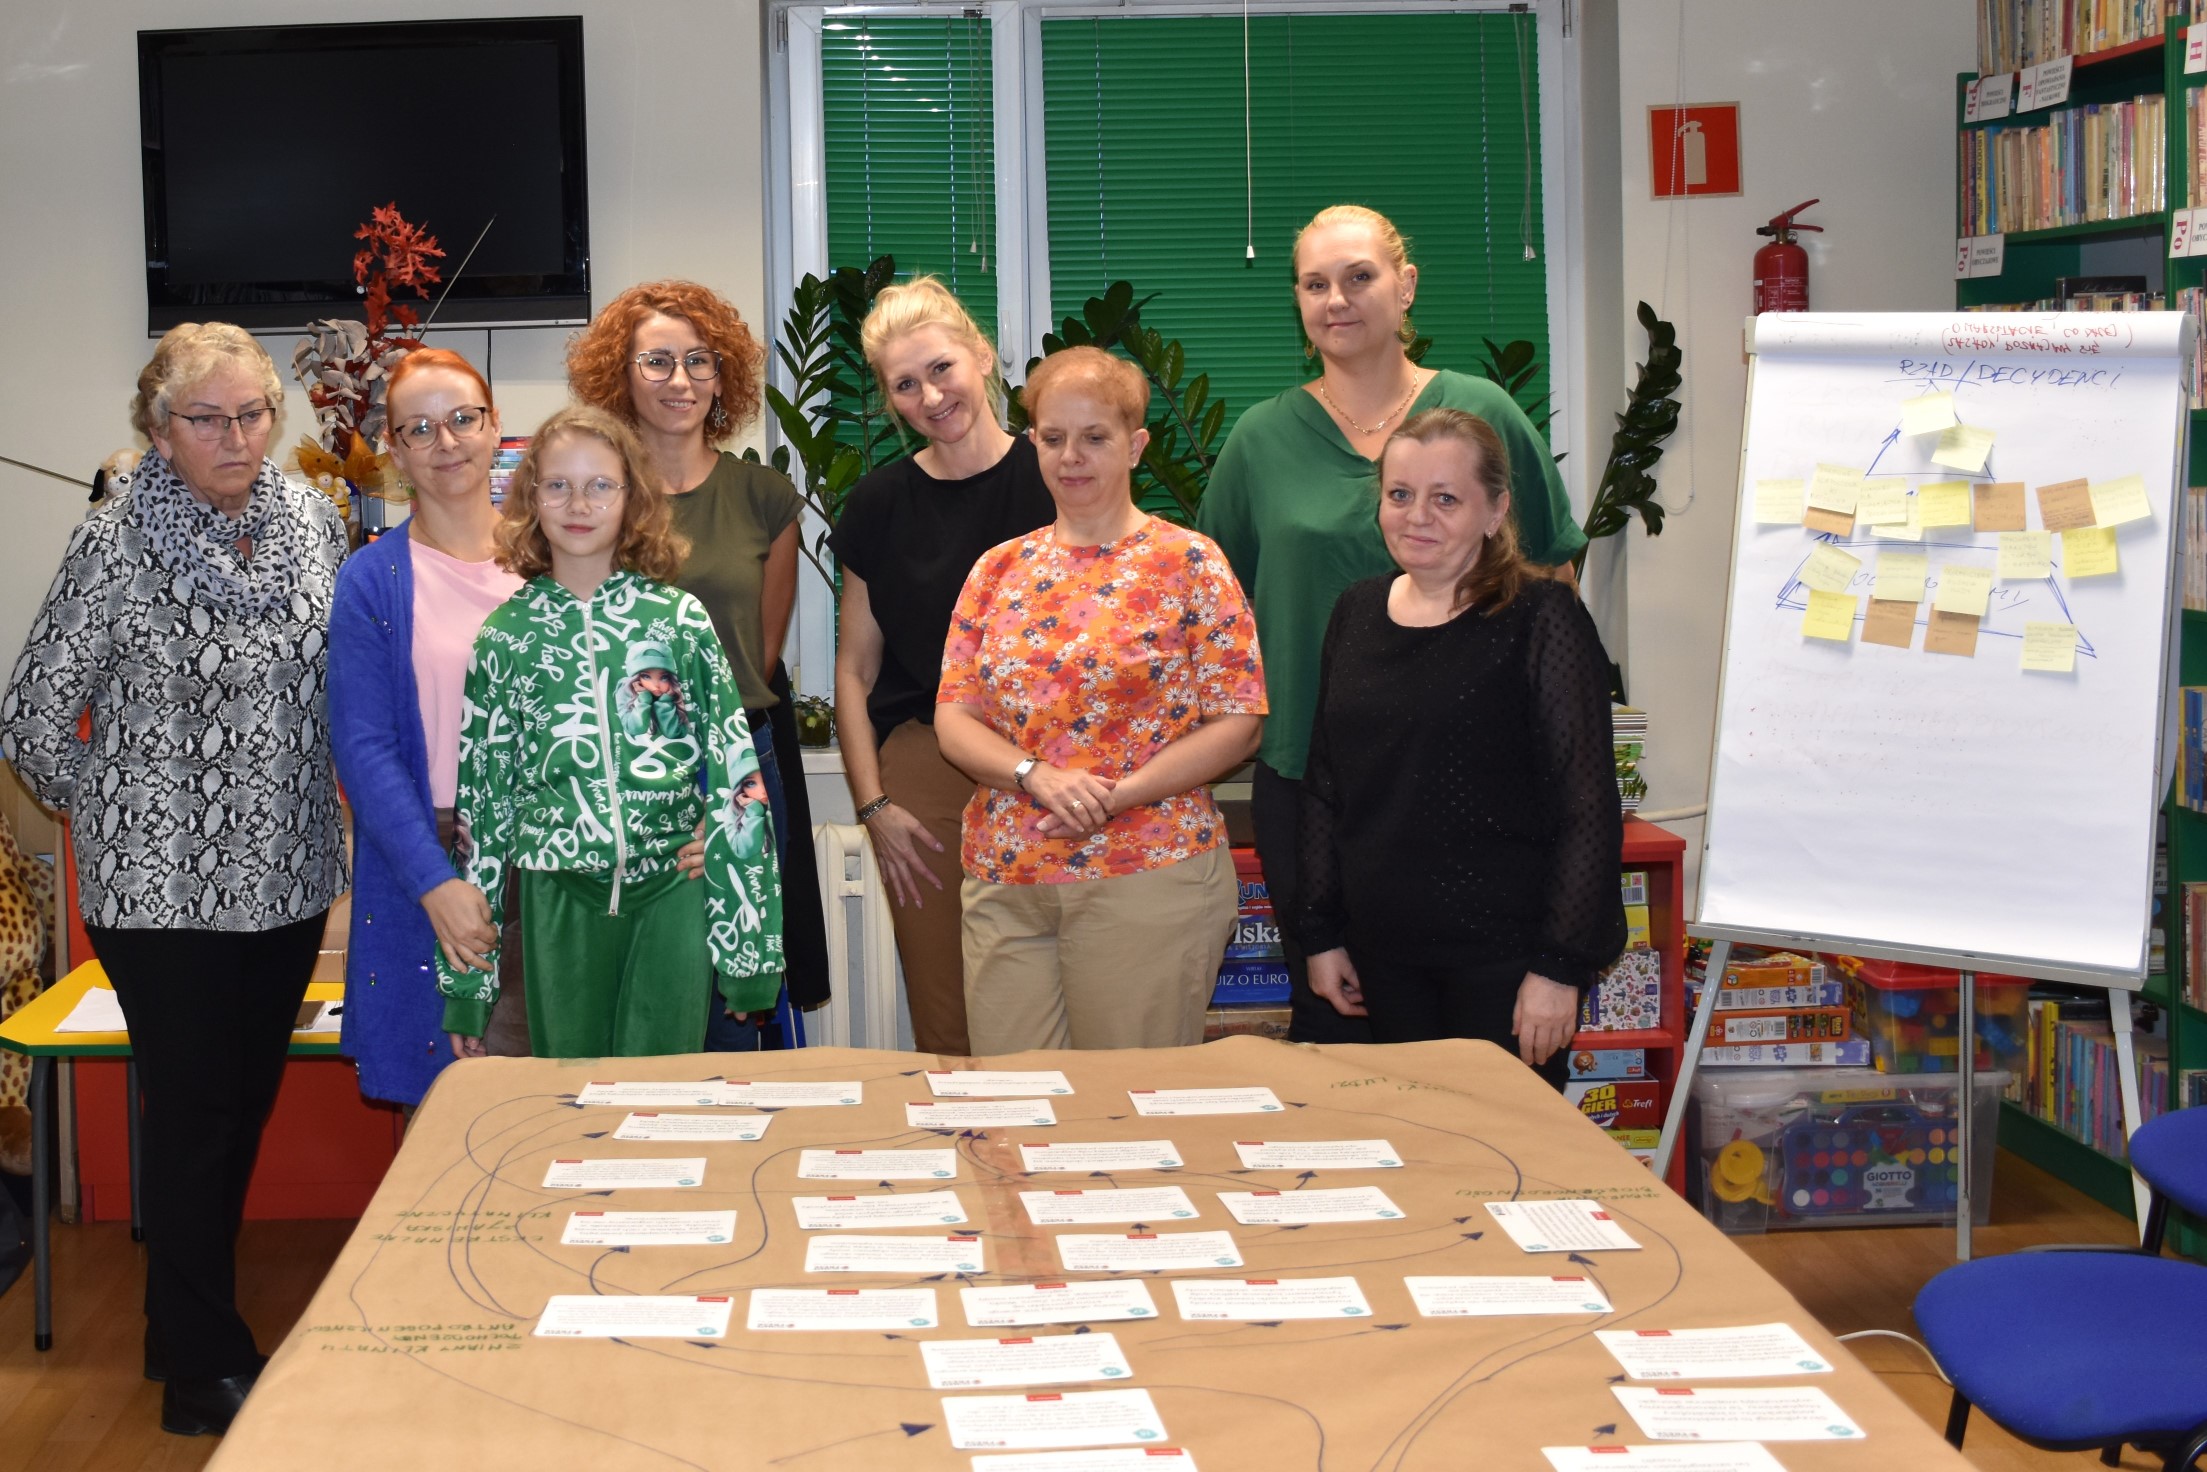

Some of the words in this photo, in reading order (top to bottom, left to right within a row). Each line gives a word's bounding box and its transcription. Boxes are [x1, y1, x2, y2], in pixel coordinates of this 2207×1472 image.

[2189, 41, 2202, 61] H
[1584, 1084, 1616, 1103] 30
[1581, 1098, 1617, 1114] GIER
[1632, 1098, 1654, 1109] Trefl
[1866, 1170, 1912, 1181] GIOTTO
